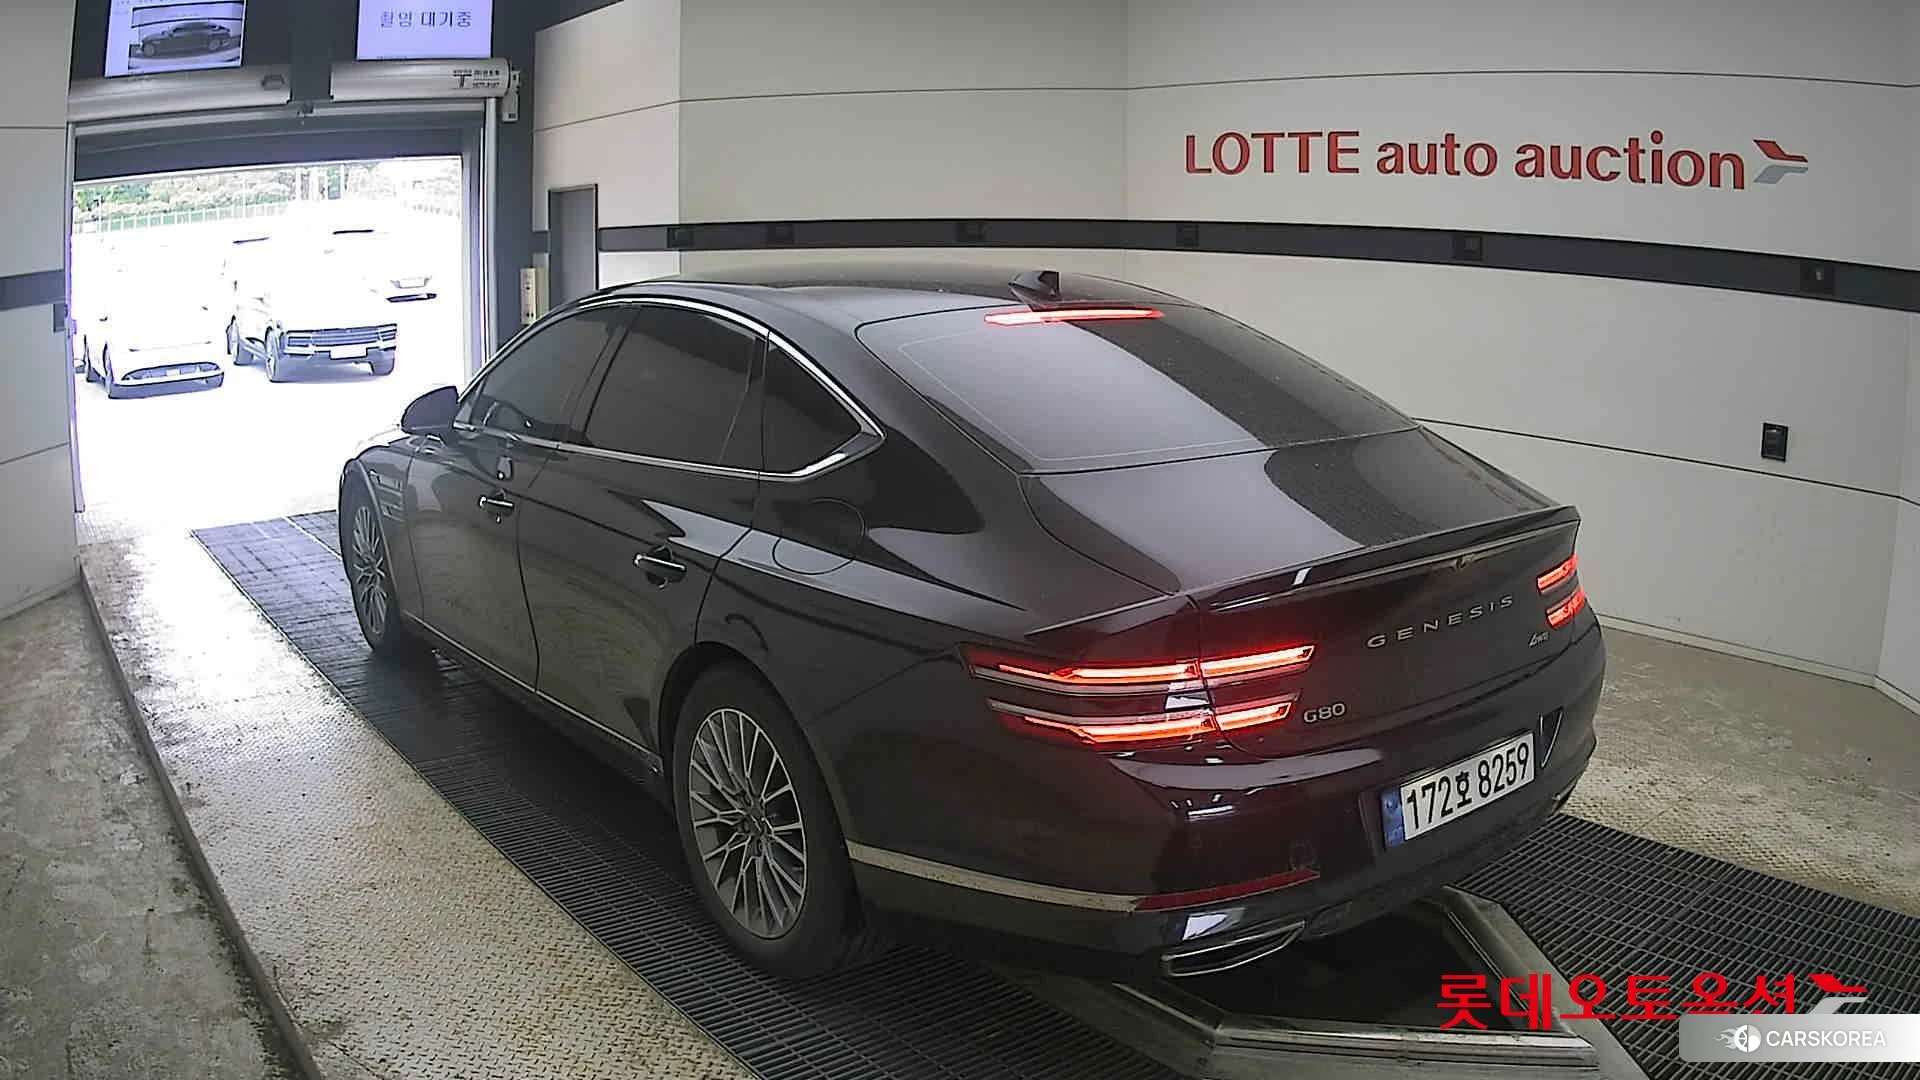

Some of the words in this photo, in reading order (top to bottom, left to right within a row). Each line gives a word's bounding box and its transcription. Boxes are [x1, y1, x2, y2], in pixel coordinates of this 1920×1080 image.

[421, 10, 472, 28] 대기중
[1184, 130, 1360, 175] LOTTE
[1376, 132, 1498, 177] auto
[1513, 130, 1745, 190] auction
[1367, 596, 1513, 648] GENESIS
[1303, 703, 1346, 724] G80
[1406, 770, 1473, 830] 172호
[1477, 741, 1530, 798] 8259
